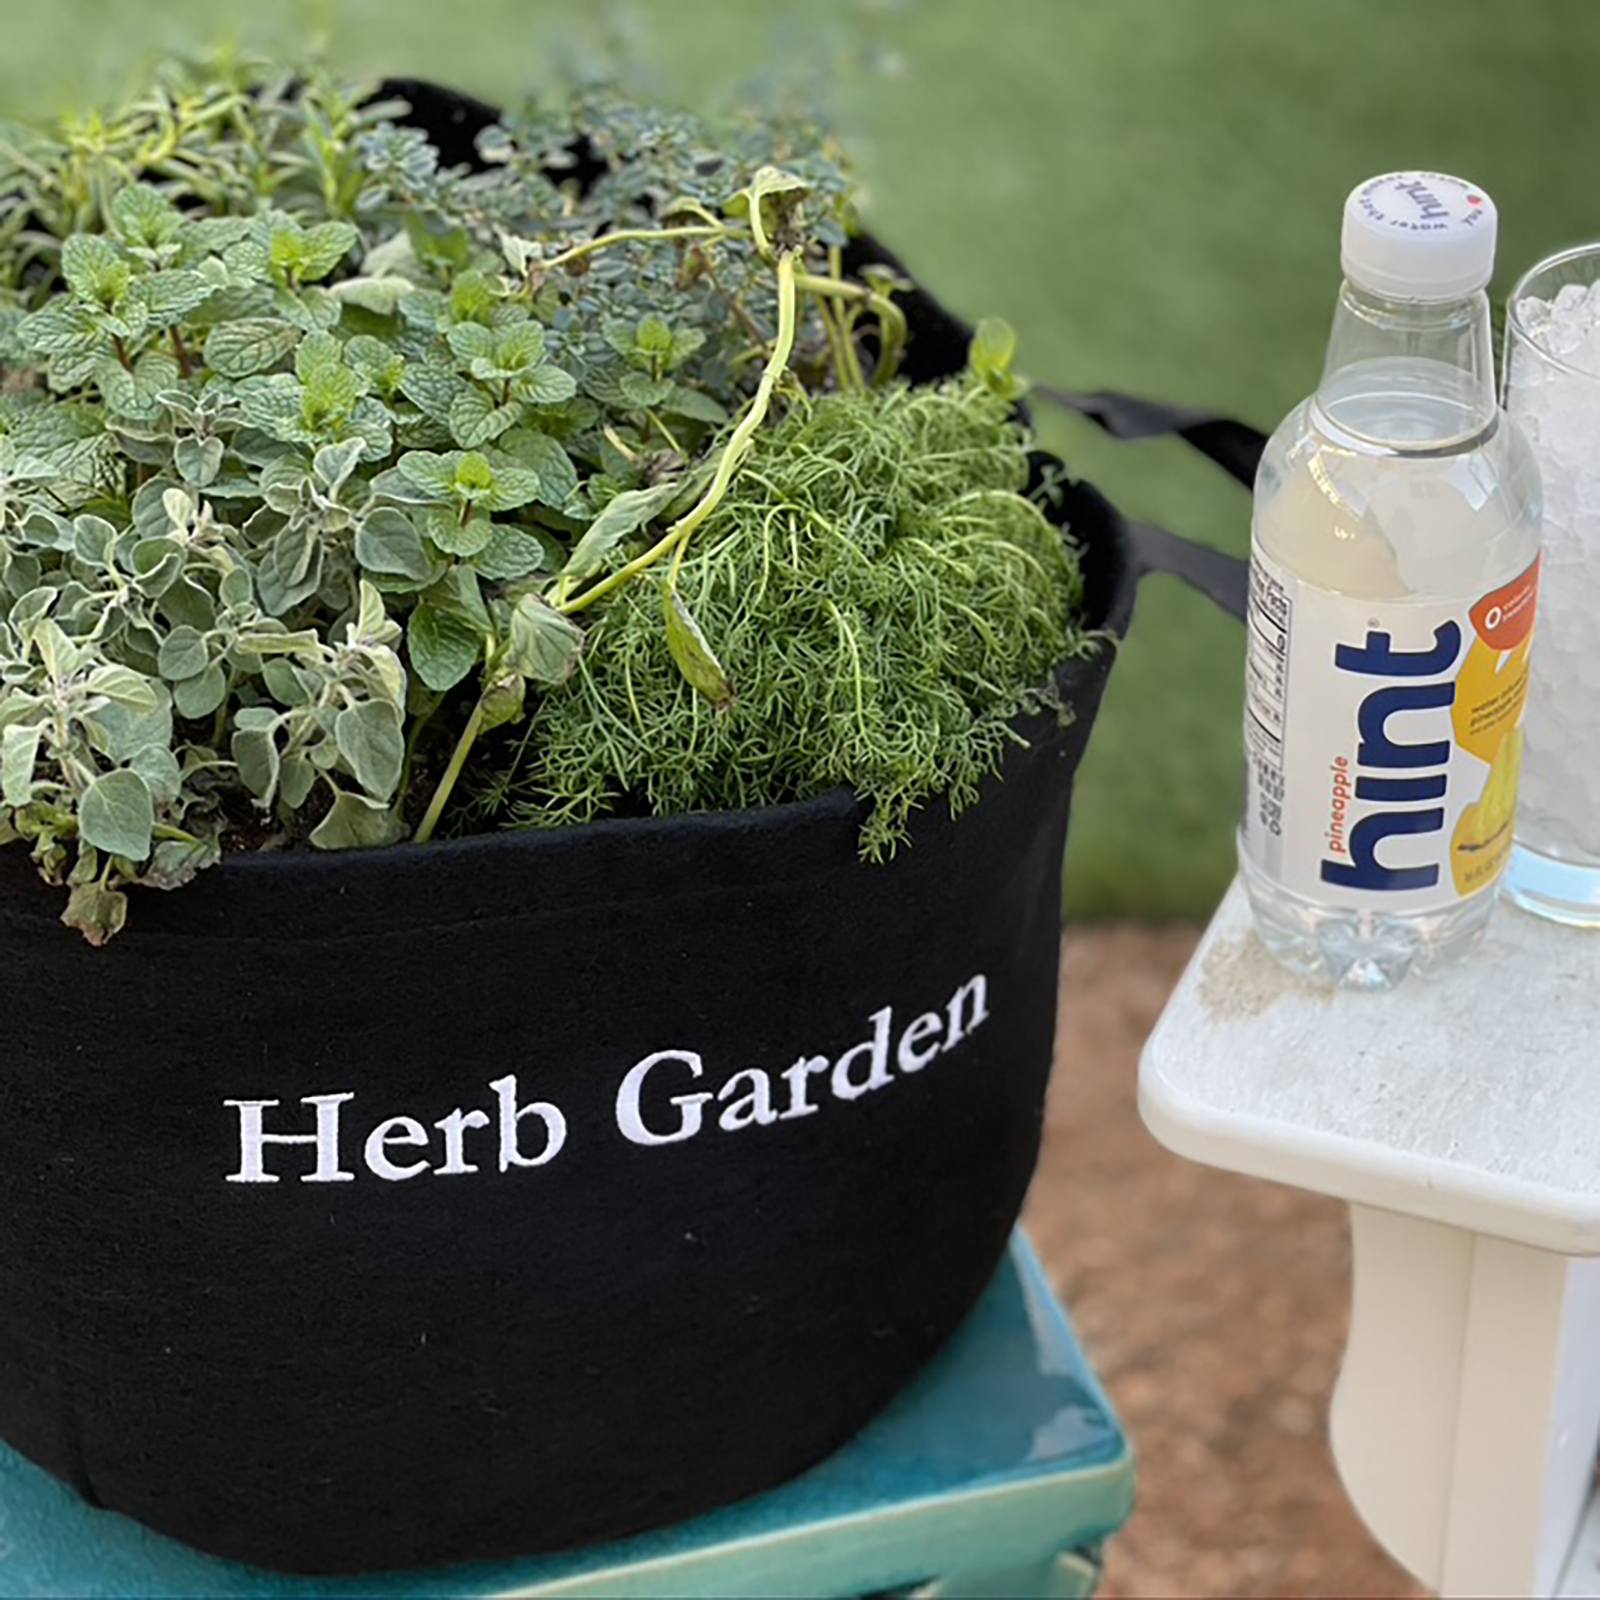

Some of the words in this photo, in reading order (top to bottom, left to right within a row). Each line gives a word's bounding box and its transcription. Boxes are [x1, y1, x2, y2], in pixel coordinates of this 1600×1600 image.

[1321, 619, 1462, 892] hint
[1325, 756, 1351, 854] pineapple
[223, 1074, 567, 1183] Herb
[615, 974, 988, 1147] Garden
